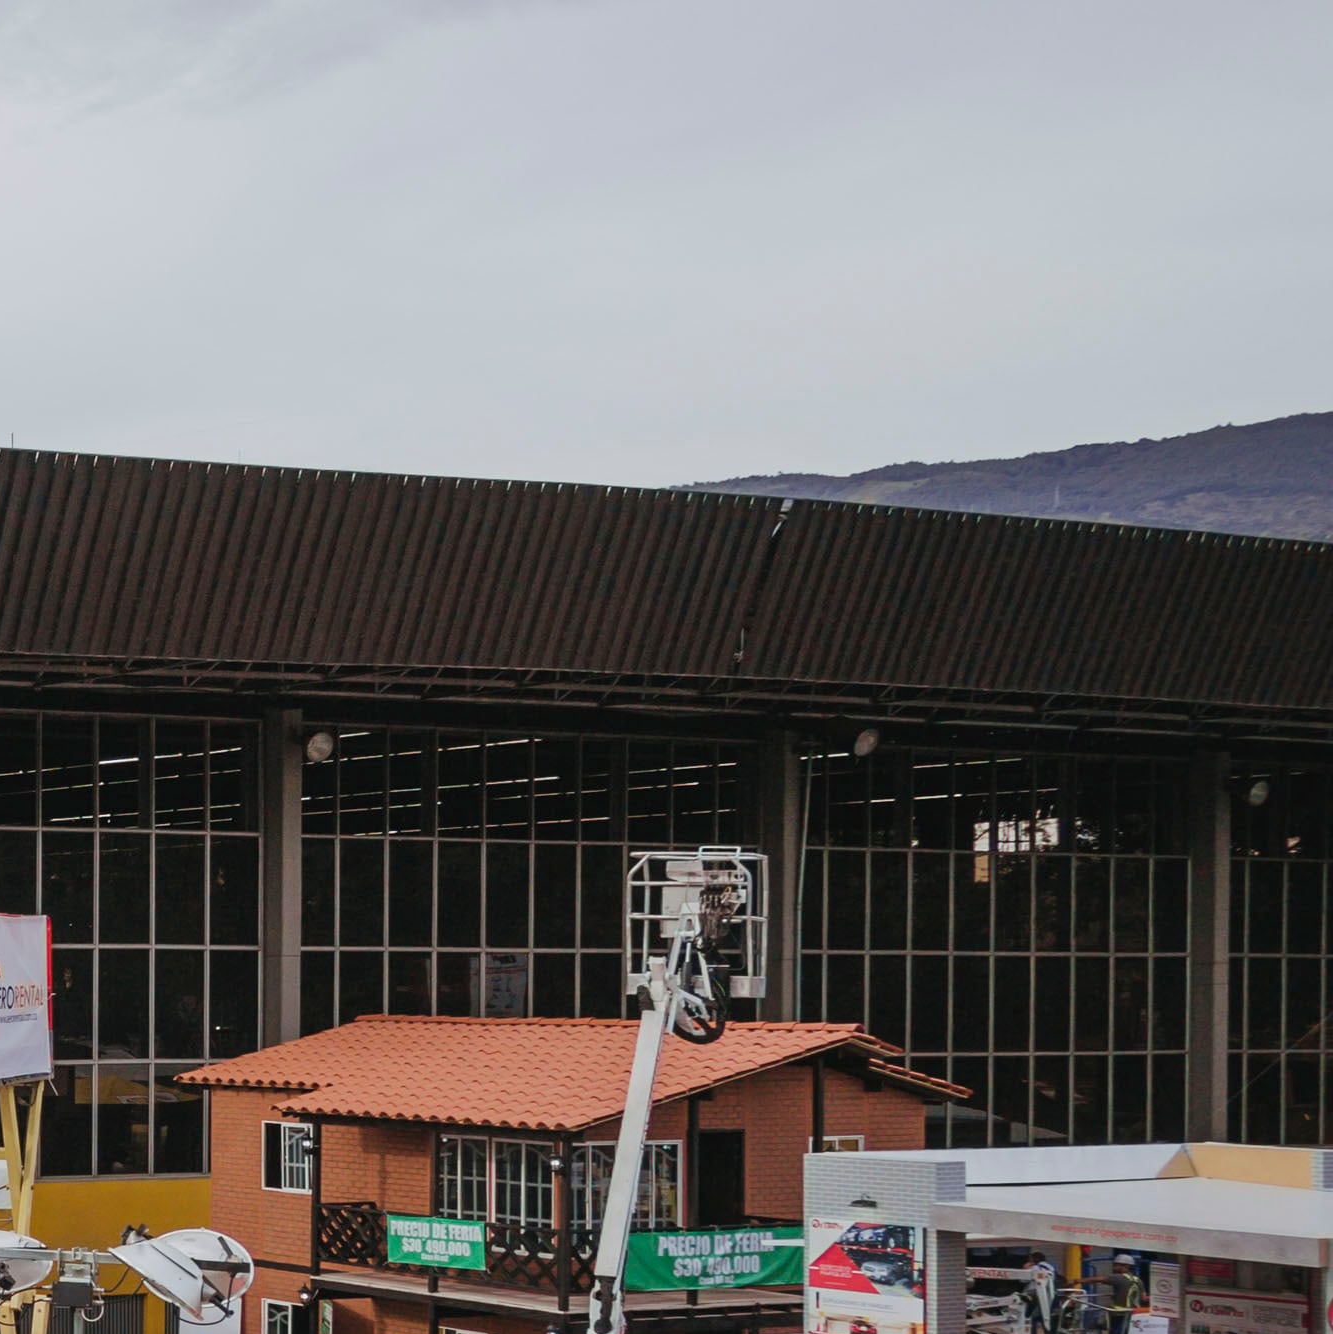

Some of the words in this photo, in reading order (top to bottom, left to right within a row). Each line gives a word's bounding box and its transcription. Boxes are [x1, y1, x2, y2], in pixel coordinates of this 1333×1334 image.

[390, 1219, 431, 1238] PRECIO
[431, 1222, 448, 1240] DE
[448, 1223, 483, 1243] FERIA
[657, 1234, 711, 1257] PRECIO
[714, 1233, 732, 1255] DE
